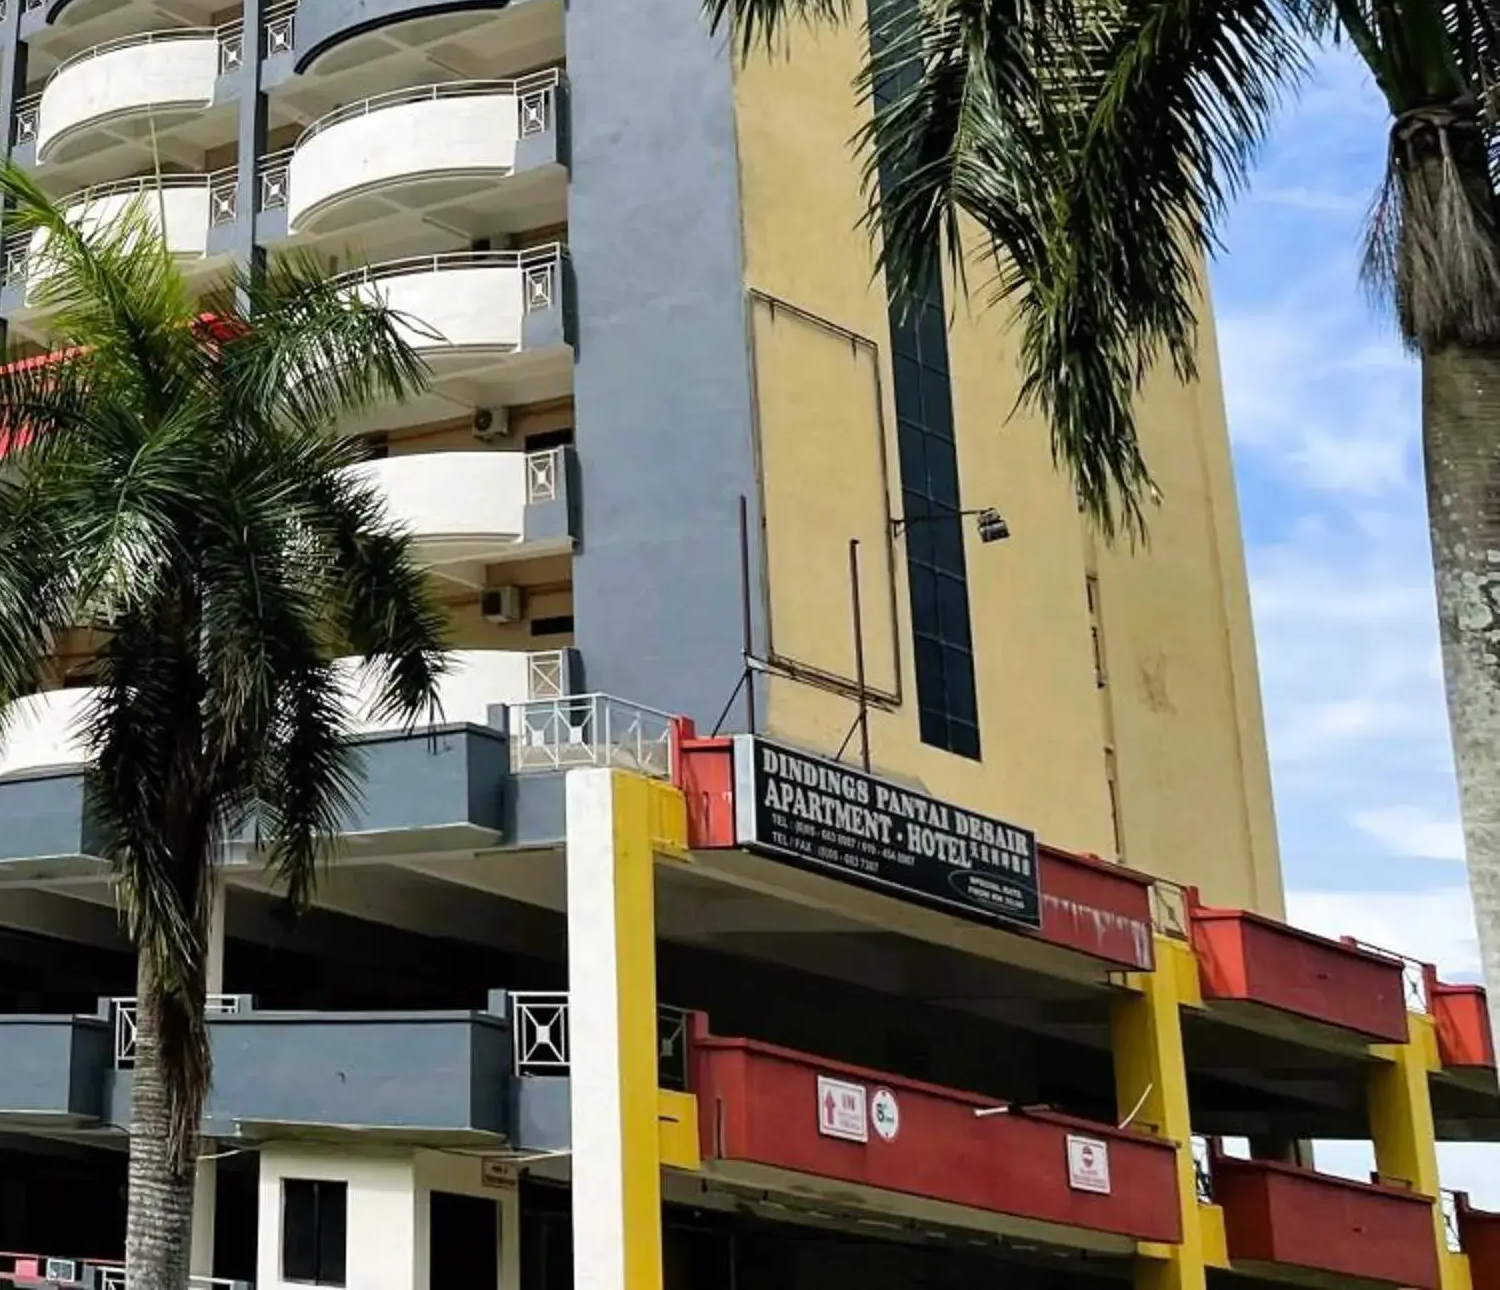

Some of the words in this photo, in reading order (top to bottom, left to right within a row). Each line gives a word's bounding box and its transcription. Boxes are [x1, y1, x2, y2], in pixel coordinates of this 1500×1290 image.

[763, 747, 869, 804] DINDINGS
[876, 784, 950, 831] PANTAI
[955, 811, 1029, 857] DESAIR
[764, 777, 892, 844] APARTMENT
[906, 822, 973, 869] HOTEL
[772, 831, 788, 847] TEL
